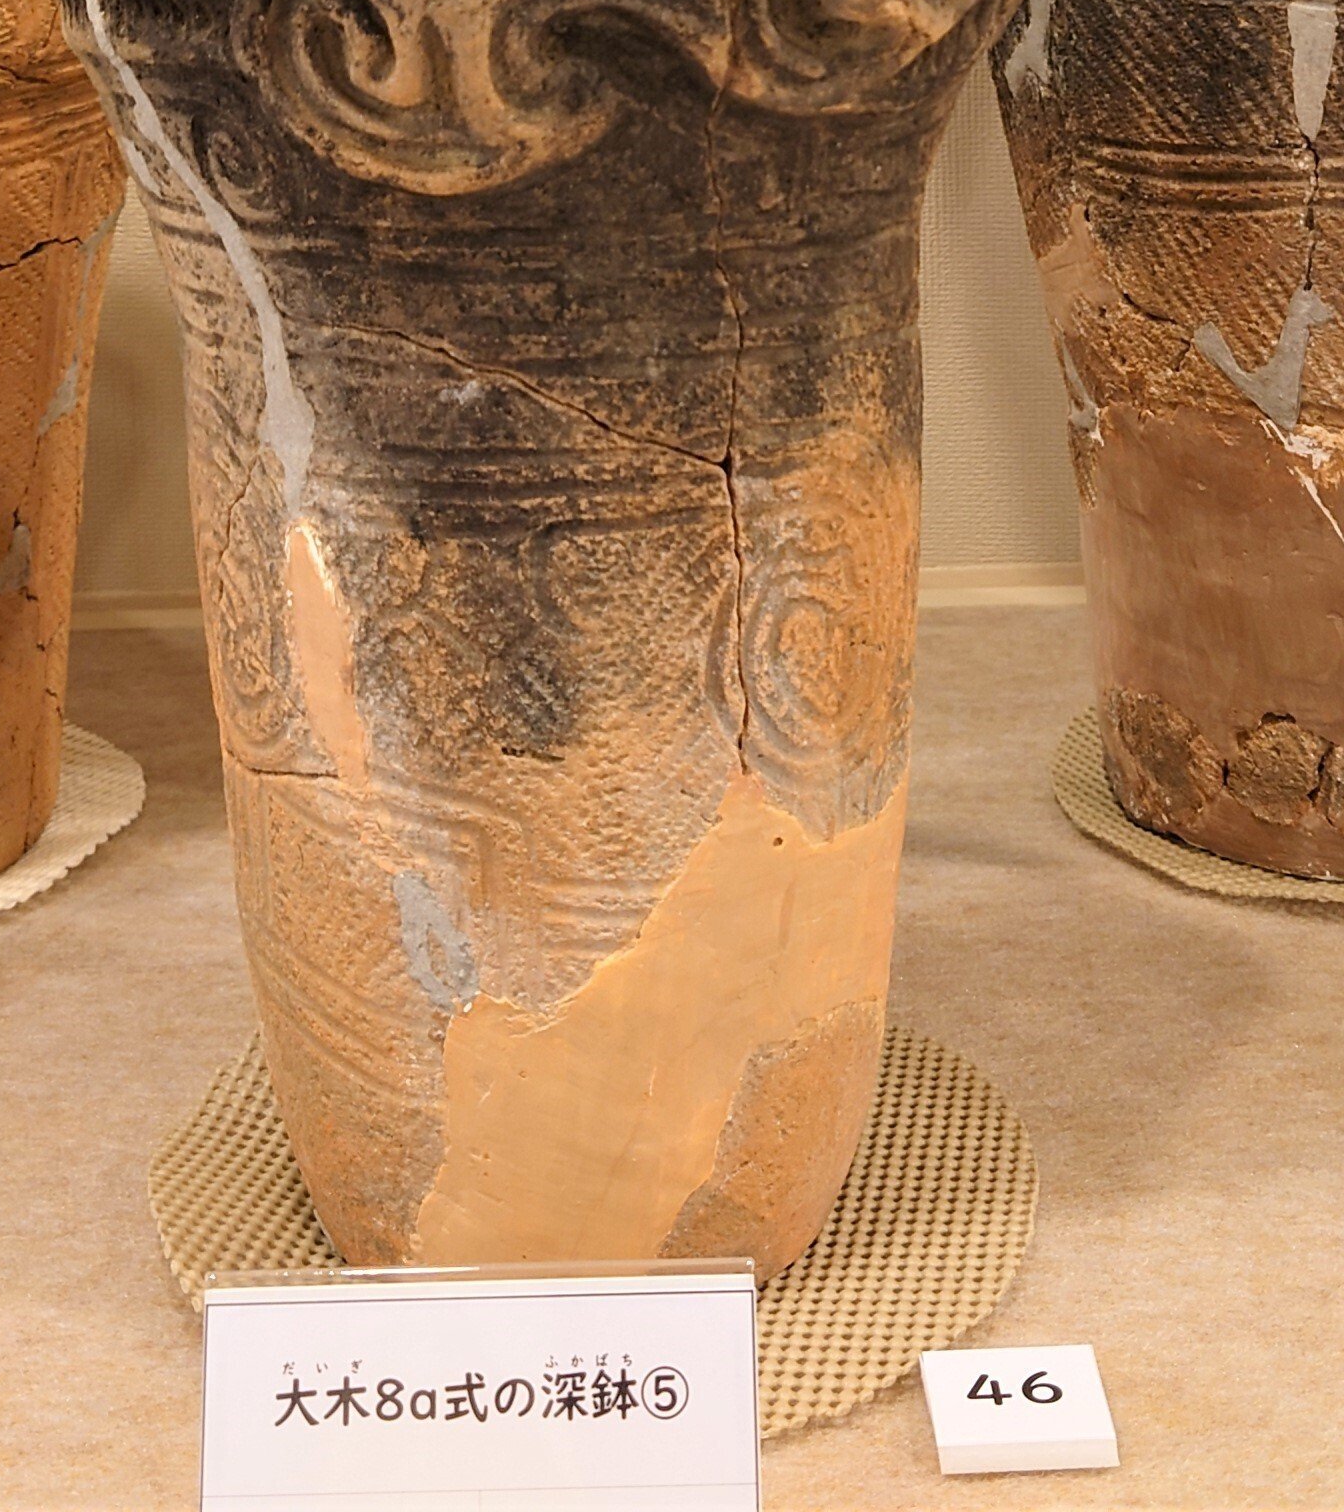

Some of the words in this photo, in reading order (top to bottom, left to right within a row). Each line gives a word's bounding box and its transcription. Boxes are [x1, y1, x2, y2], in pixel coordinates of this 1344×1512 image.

[274, 1366, 690, 1428] 大木8a式の深鉢⑤
[966, 1370, 1064, 1407] 46
